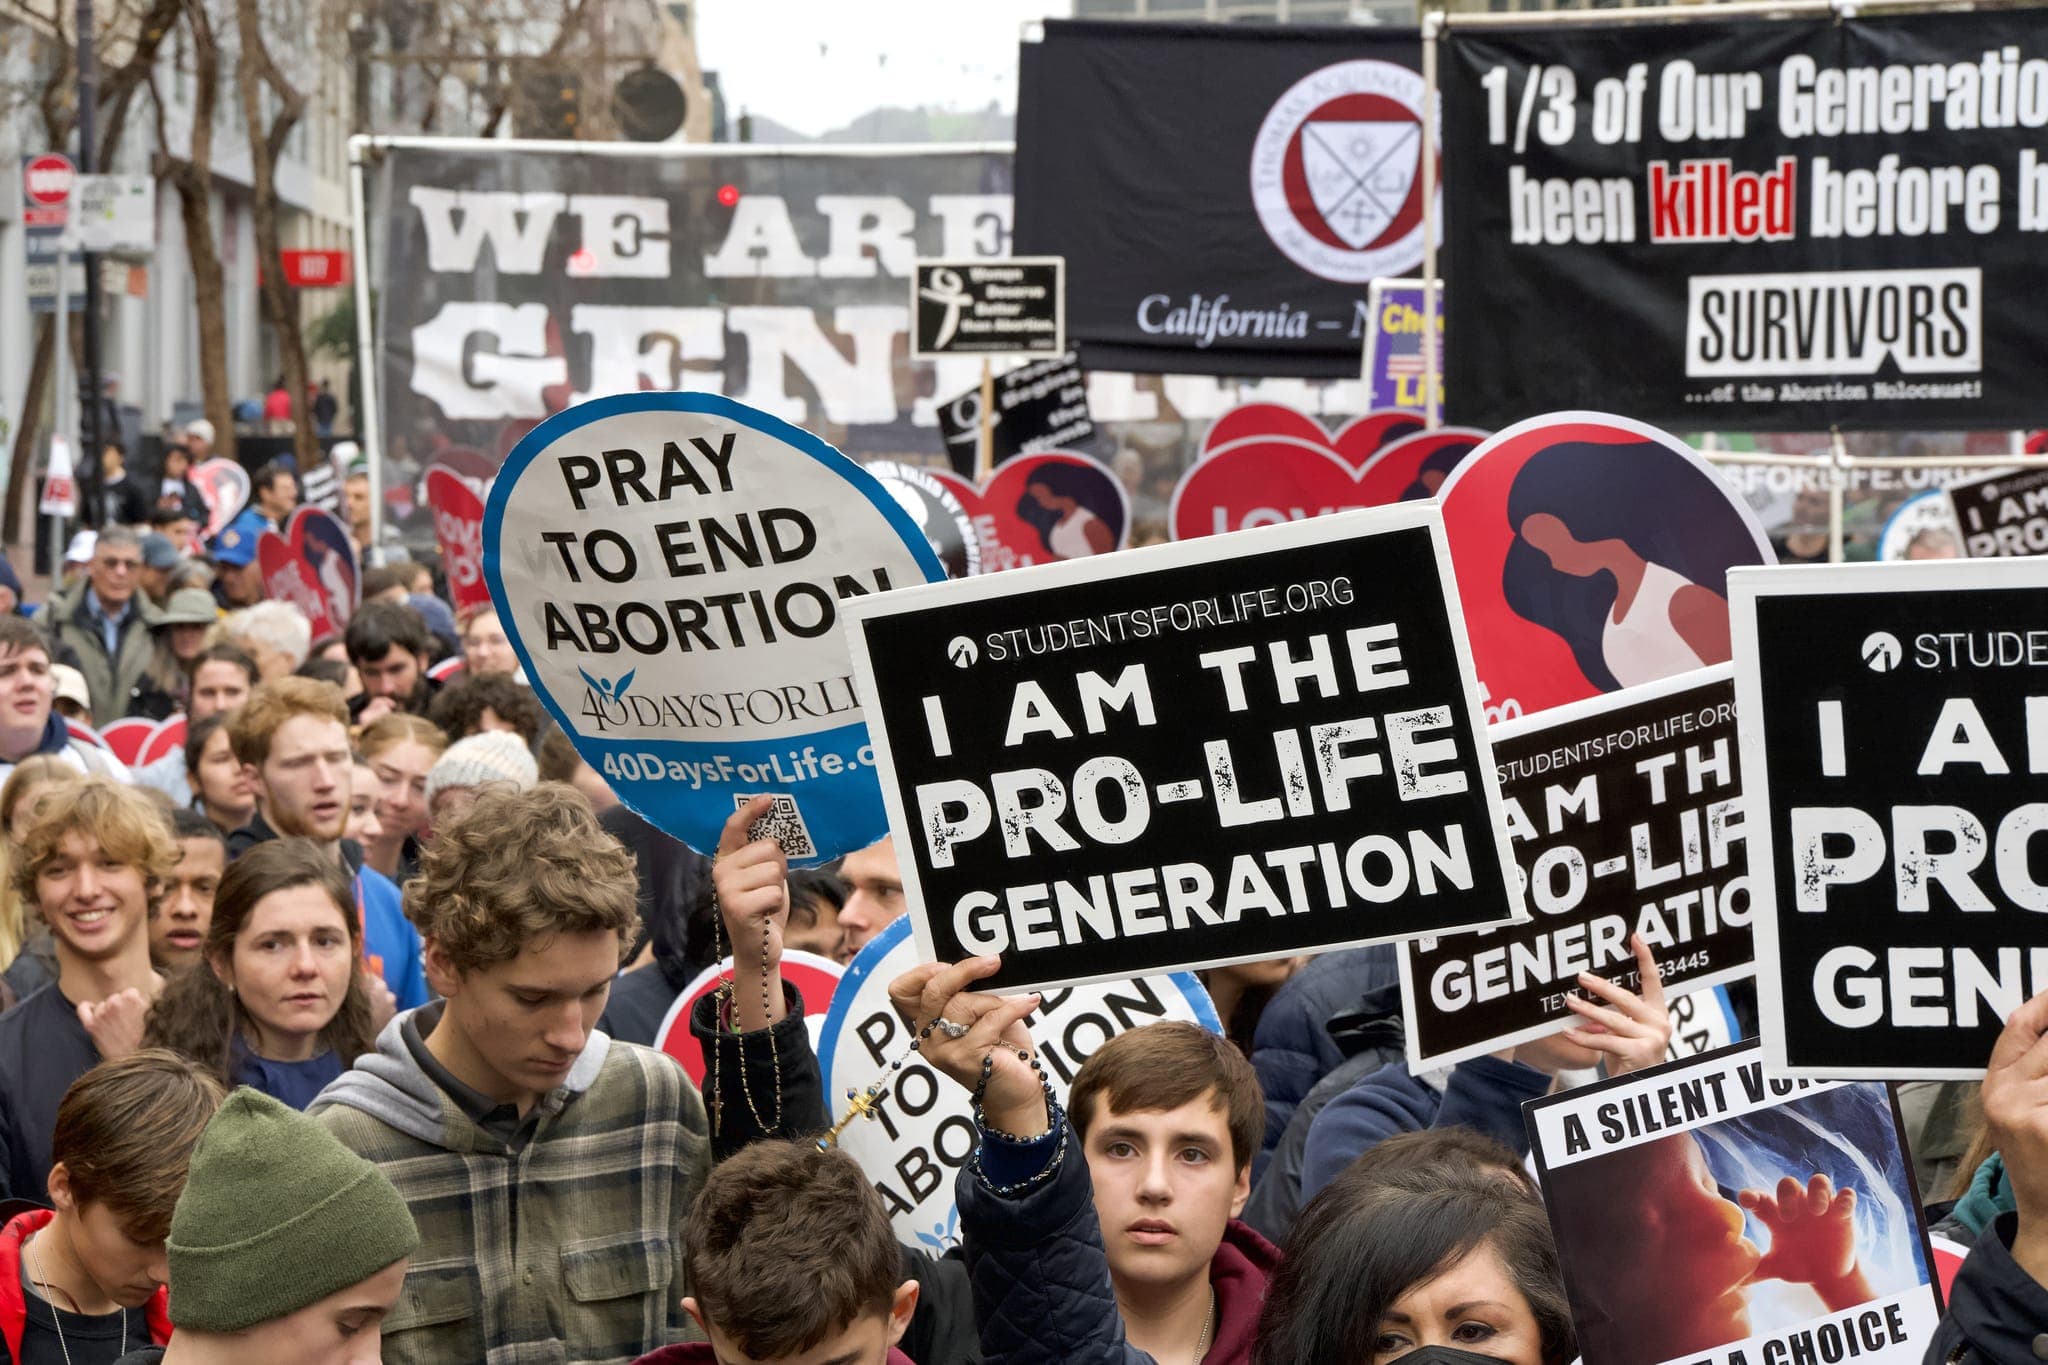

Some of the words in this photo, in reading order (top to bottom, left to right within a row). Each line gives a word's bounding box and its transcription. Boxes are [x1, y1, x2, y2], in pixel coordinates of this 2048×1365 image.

[1481, 65, 1577, 153] 1/3
[1592, 63, 1648, 143] of
[1658, 60, 1762, 142] Our
[410, 186, 671, 278] WE
[703, 194, 1014, 279] ARE
[1509, 165, 1635, 245] been
[1648, 156, 1797, 245] killed
[1810, 154, 2000, 238] before
[1137, 293, 1308, 348] California
[1699, 282, 1968, 363] SURVIVORS
[1742, 384, 1775, 401] the
[1779, 382, 1868, 401] Abortion
[559, 433, 737, 511] PRAY
[542, 529, 637, 583] TO
[655, 507, 817, 578] END
[1967, 507, 1984, 531] I
[986, 576, 1355, 663] STUDENTSFORLIFE.ORG
[922, 695, 952, 757] I
[1003, 663, 1157, 748] AM
[1200, 622, 1410, 713] THE
[1818, 700, 1846, 777] I
[914, 704, 1470, 871] PRO-LIFE
[952, 822, 1475, 959] GENERATION
[873, 1064, 939, 1142] TO
[1562, 1112, 1592, 1156] A
[1596, 1071, 1728, 1145] SILENT
[1762, 1303, 1908, 1365] CHOICE
